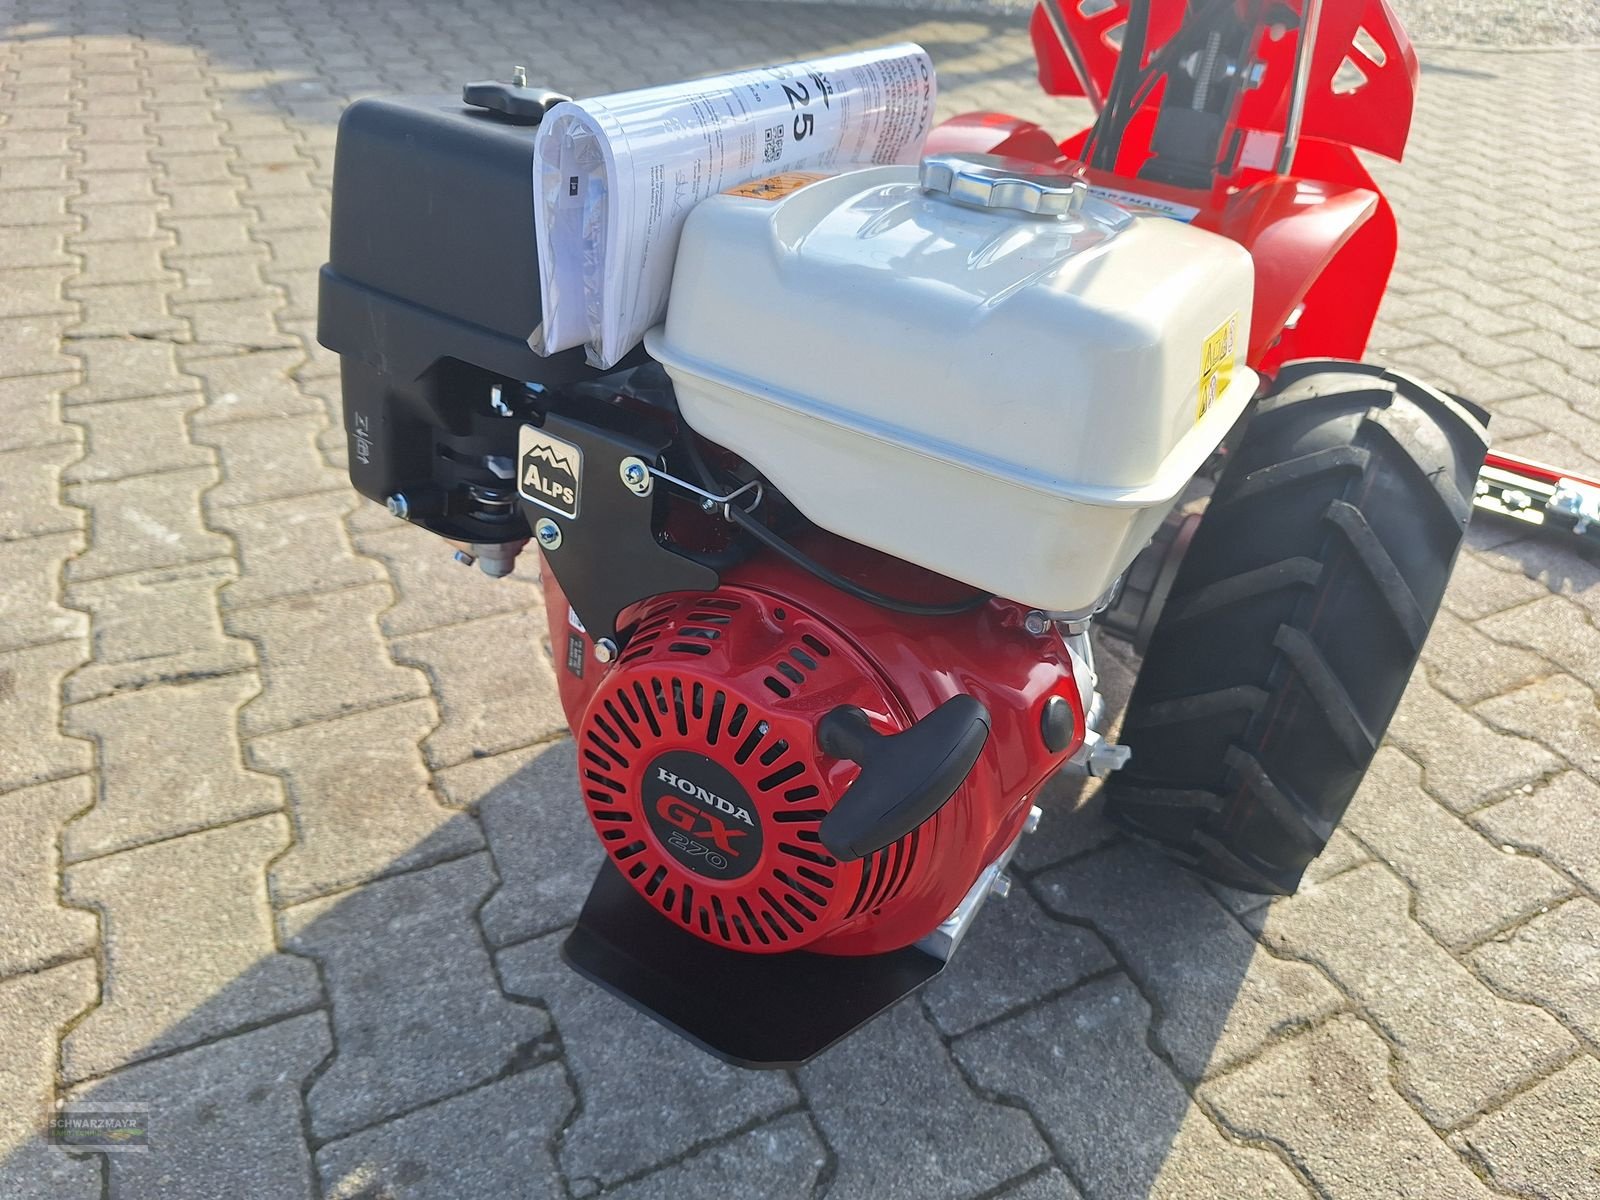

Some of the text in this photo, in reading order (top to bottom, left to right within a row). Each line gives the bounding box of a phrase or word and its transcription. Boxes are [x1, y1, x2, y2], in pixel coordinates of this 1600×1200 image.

[656, 794, 749, 857] GX
[657, 767, 755, 827] HONDA
[667, 831, 729, 870] 270
